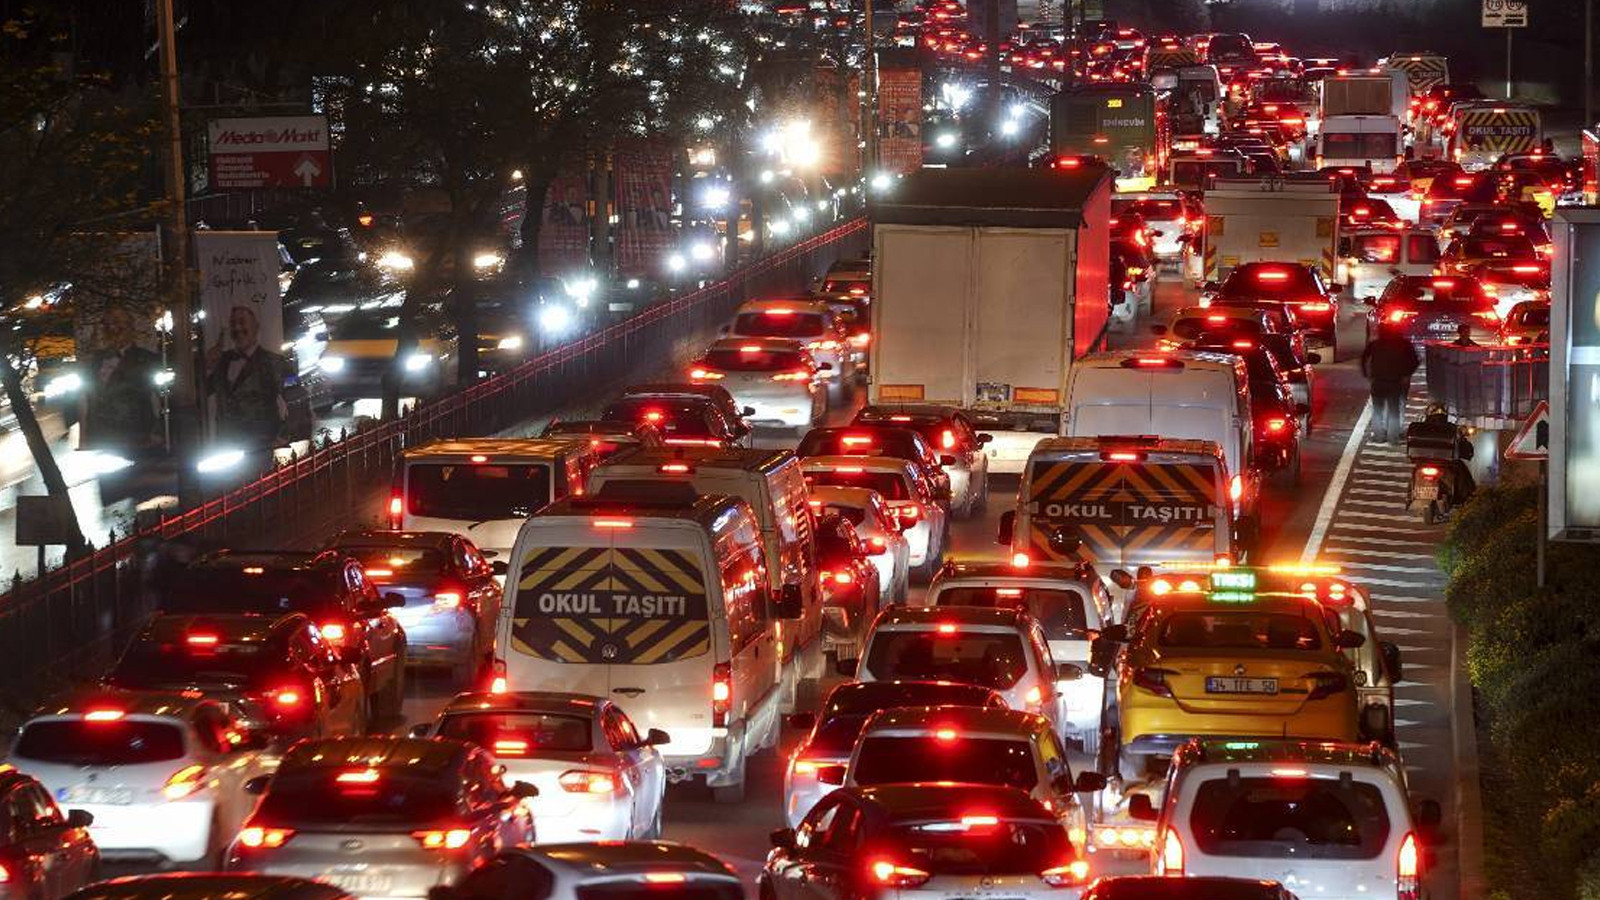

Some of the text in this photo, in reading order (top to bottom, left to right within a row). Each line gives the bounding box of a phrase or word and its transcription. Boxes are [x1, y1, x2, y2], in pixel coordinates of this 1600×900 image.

[216, 129, 320, 144] Media Markt
[1468, 127, 1496, 135] OKUL
[1045, 504, 1203, 522] OKUL TAŞITI
[538, 594, 686, 617] OKUL TAŞITI
